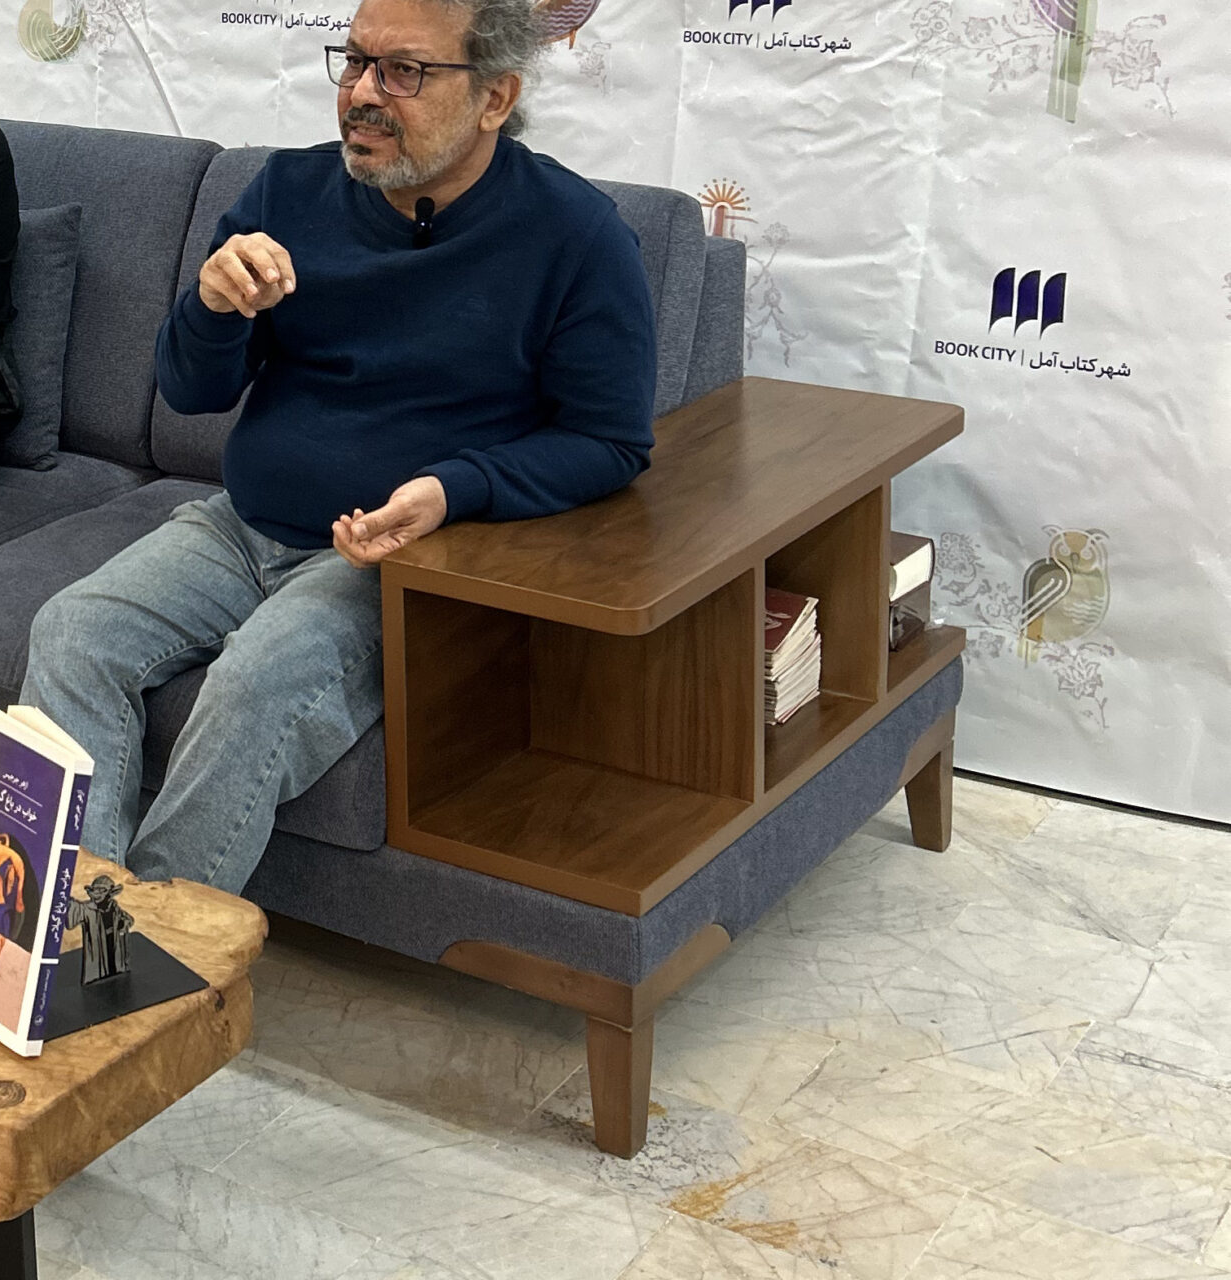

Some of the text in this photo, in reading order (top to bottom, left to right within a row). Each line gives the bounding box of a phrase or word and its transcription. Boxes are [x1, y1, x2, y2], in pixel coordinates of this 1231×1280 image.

[221, 12, 278, 26] BOOK CITY
[284, 12, 305, 30] آمل
[683, 30, 754, 46] BOOK CITY
[763, 31, 789, 50] آمل
[934, 340, 1017, 363] BOOK CITY
[1029, 351, 1060, 370] آمل
[4, 793, 15, 813] باغ
[13, 804, 22, 814] در
[21, 807, 37, 822] خواب
[51, 867, 71, 943] خواب در باغ گیلاس
